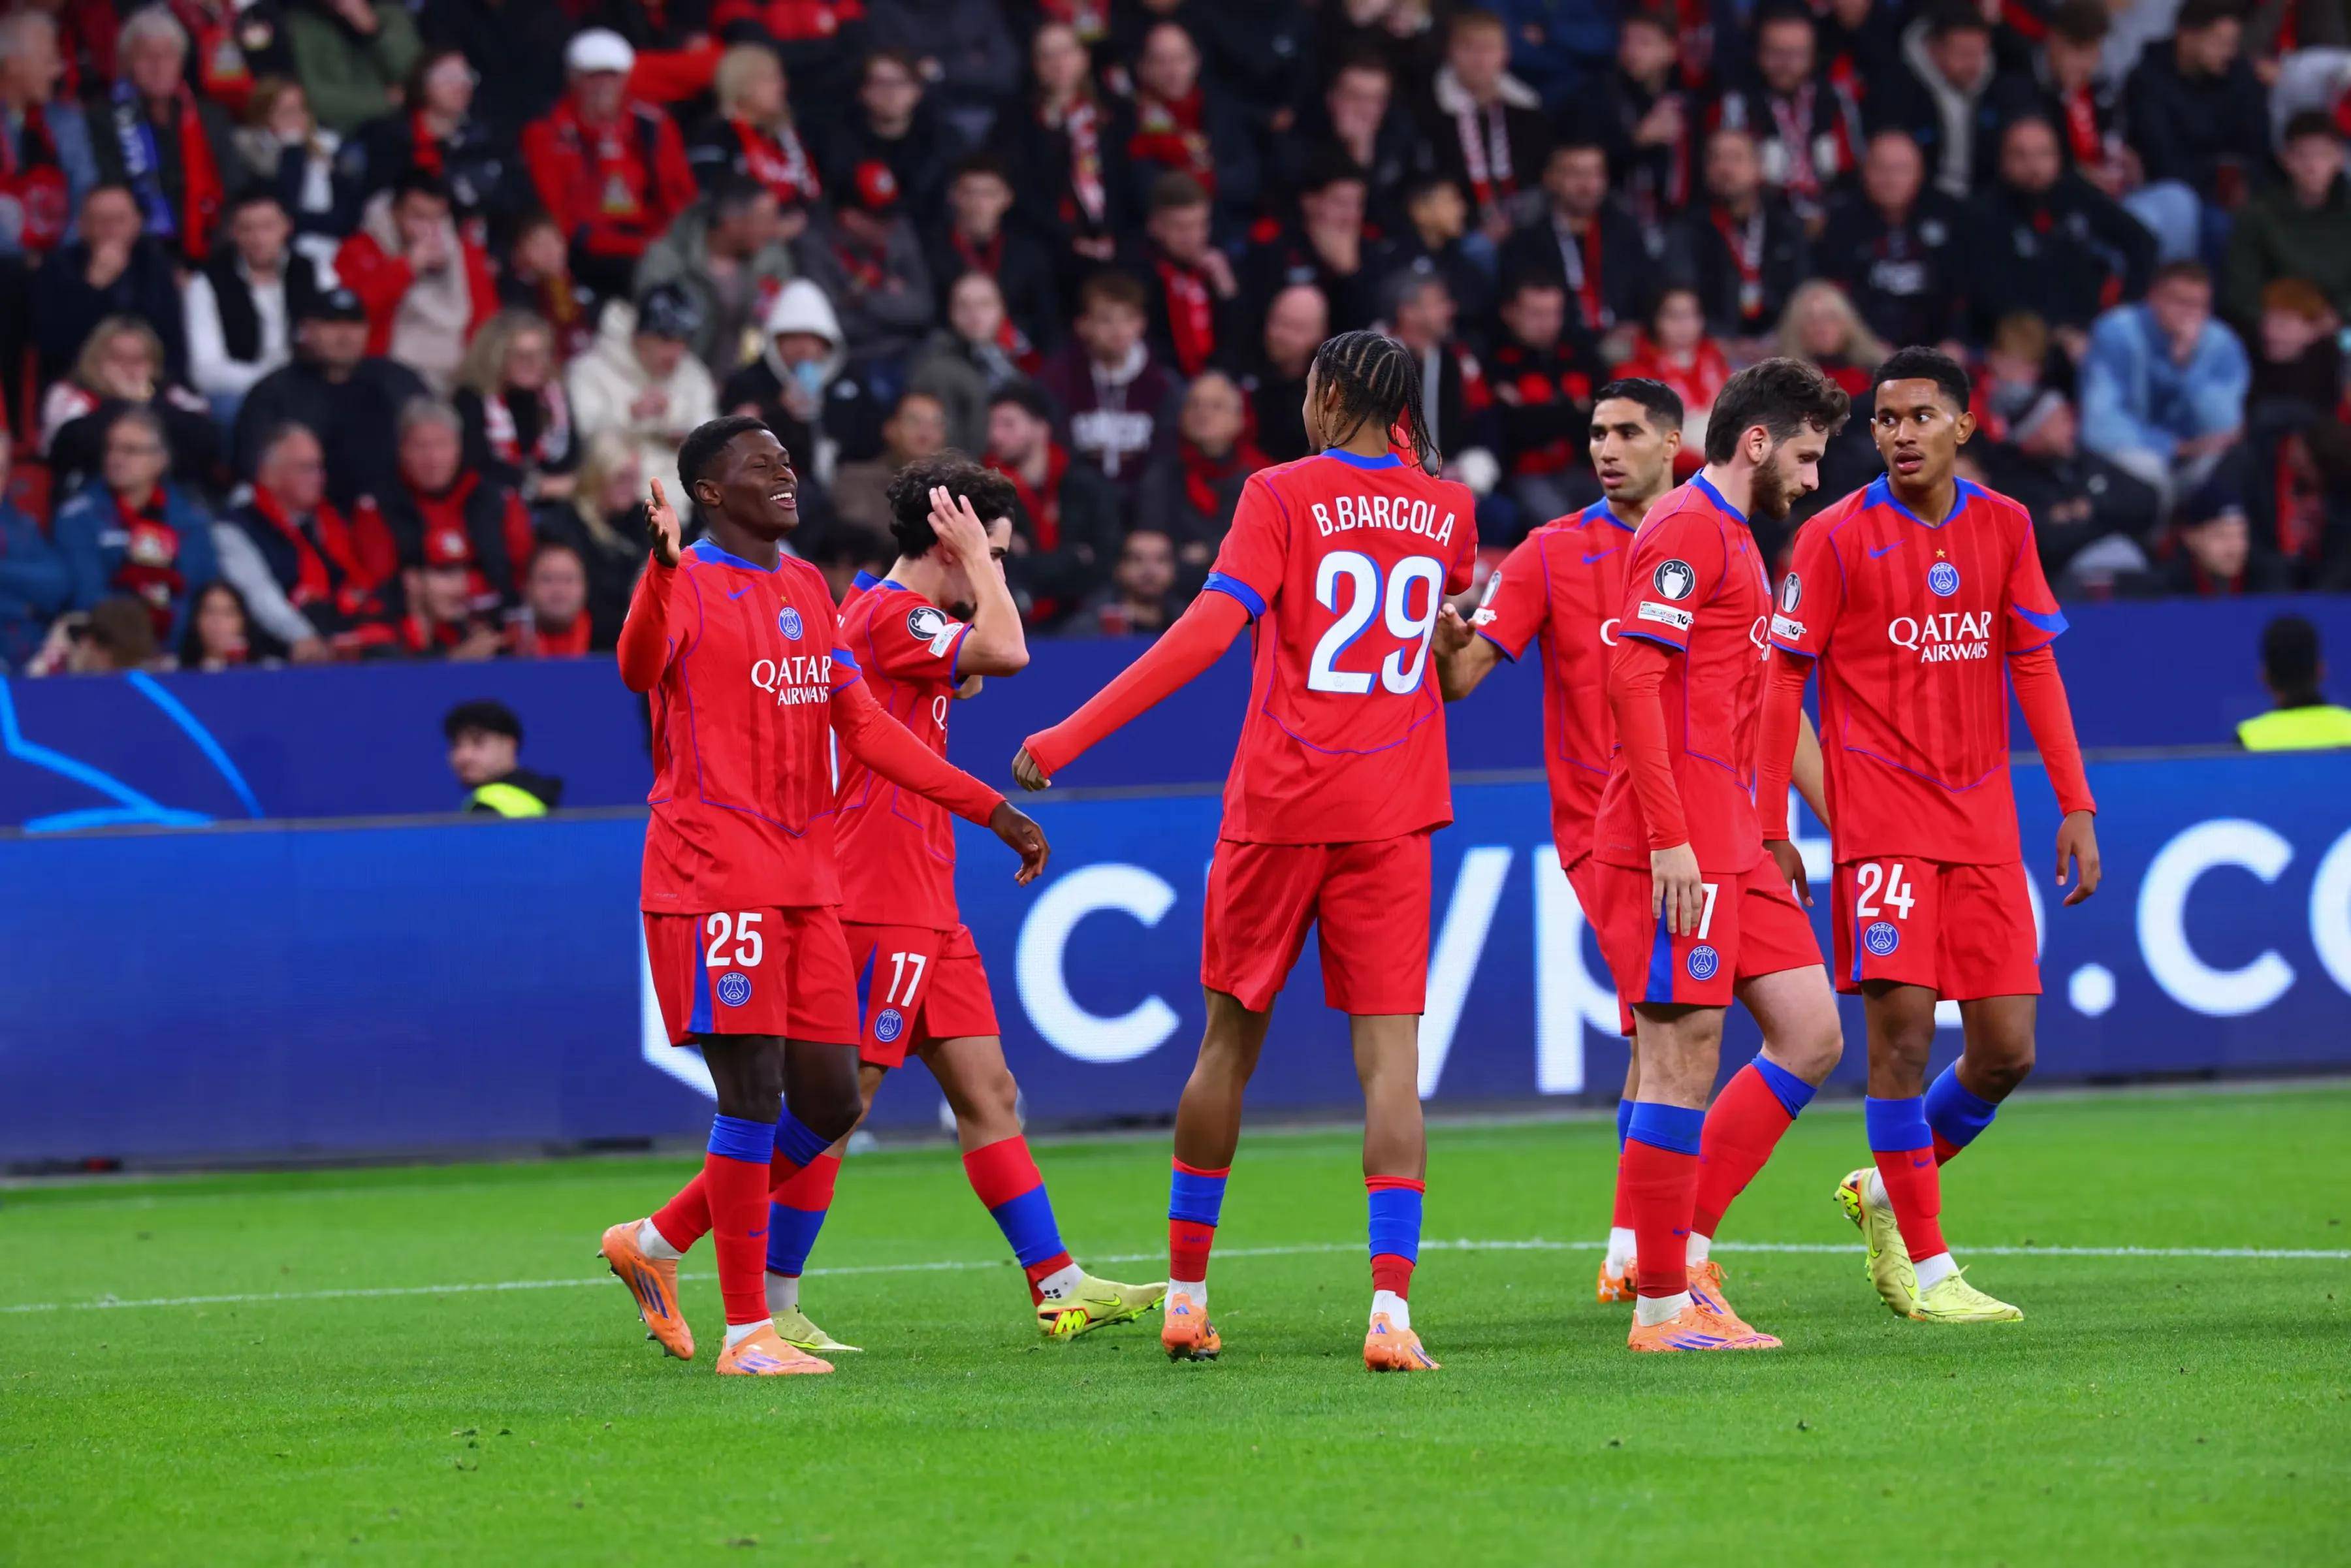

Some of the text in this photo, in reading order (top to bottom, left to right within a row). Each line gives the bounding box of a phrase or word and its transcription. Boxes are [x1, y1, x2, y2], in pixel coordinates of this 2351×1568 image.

[1311, 496, 1455, 547] B.BARCOLA
[1932, 564, 1952, 573] PARIS
[1307, 549, 1447, 695] 29
[1888, 611, 1992, 651] QATAR
[1921, 641, 1988, 663] AIRWAYS
[751, 656, 831, 694] QATAR
[778, 686, 829, 706] AIRWAYS
[1857, 863, 1915, 920] 24
[1697, 883, 1718, 939] 7
[1870, 923, 1893, 933] PARIS
[706, 912, 763, 967] 25
[1693, 948, 1714, 957] PARIS
[723, 974, 745, 983] PARIS
[886, 952, 927, 1007] 17
[882, 1012, 900, 1021] PARIS
